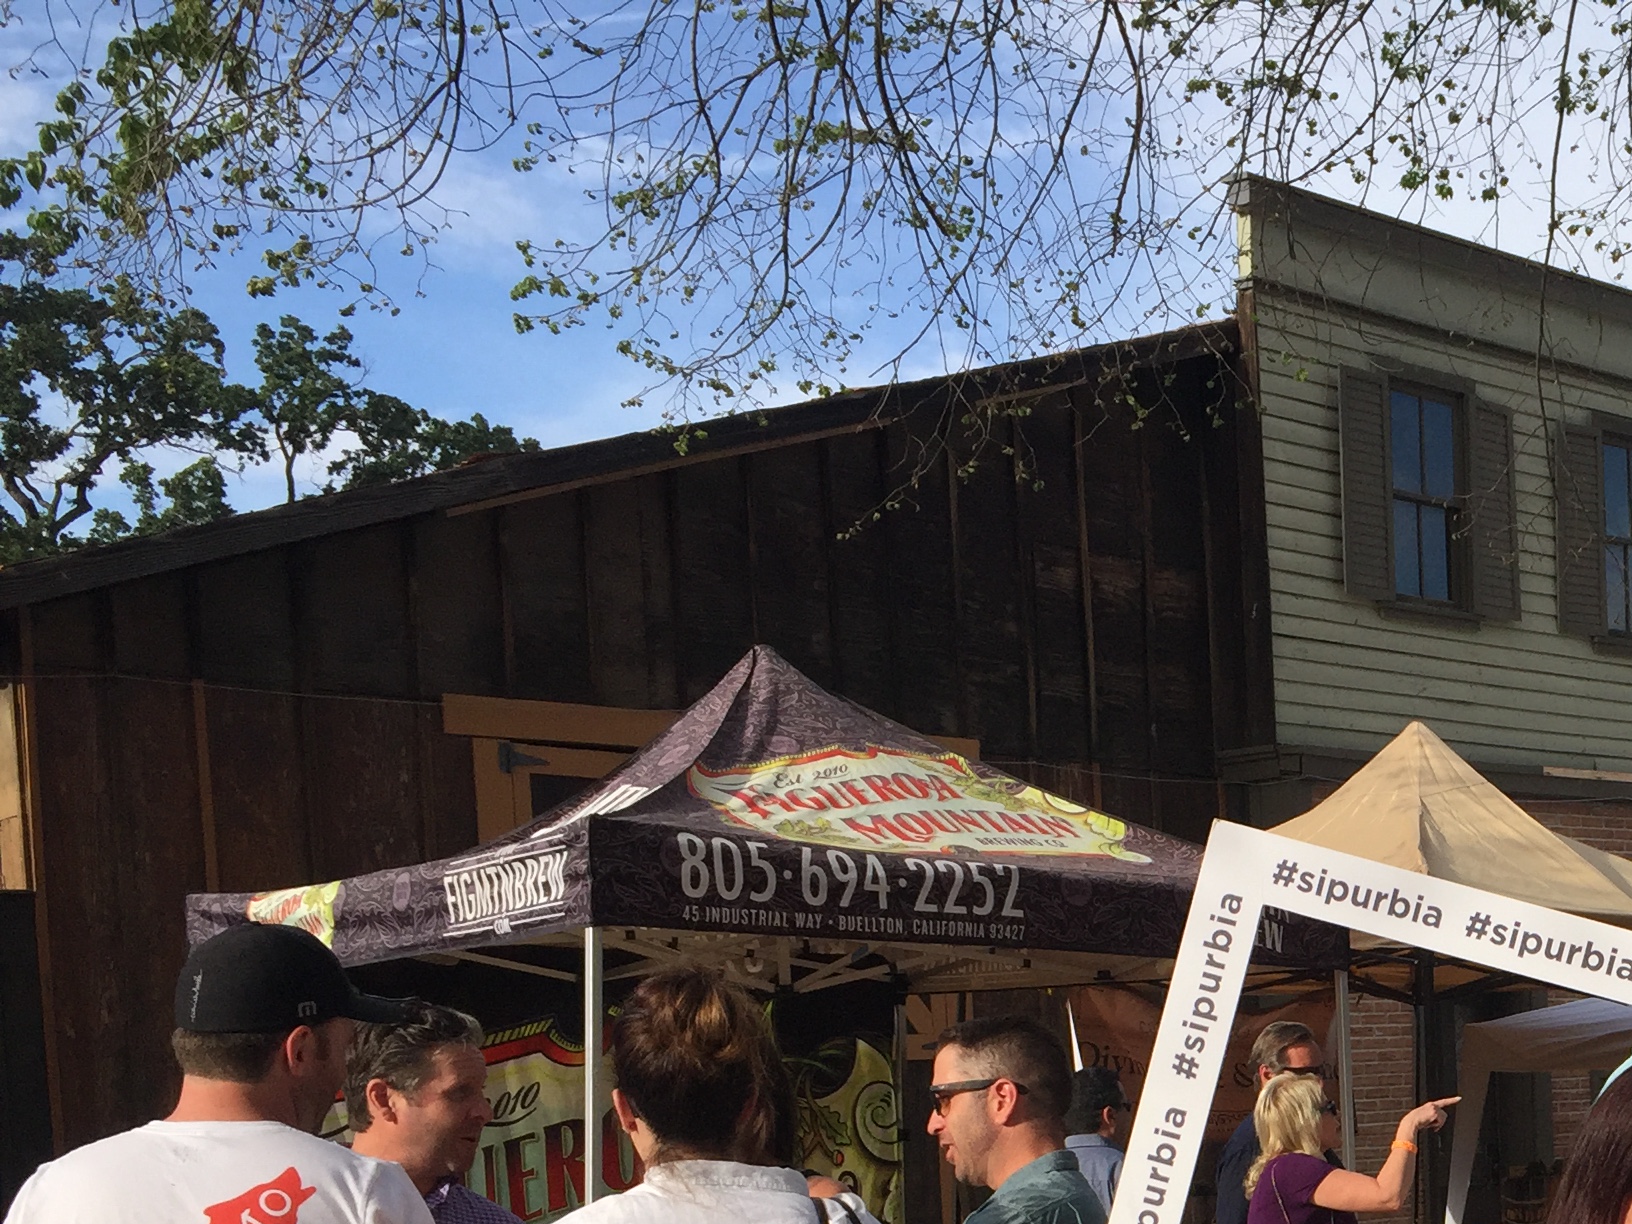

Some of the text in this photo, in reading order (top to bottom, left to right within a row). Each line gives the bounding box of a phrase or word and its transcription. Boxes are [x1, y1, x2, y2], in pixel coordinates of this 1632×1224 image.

[813, 764, 849, 780] 2010
[716, 772, 965, 819] FIGUEROA
[840, 810, 1081, 845] MOUNTAIN
[975, 837, 1043, 848] BREWING
[444, 851, 568, 923] FIGMTNBREW
[1273, 860, 1442, 928] #sipurbia
[682, 905, 700, 922] 45
[705, 906, 789, 928] INDUSTRIAL
[795, 912, 823, 929] WAY
[913, 919, 985, 939] CALIFORNIA
[989, 924, 1025, 941] 93427
[1173, 895, 1242, 1079] #sipurbia
